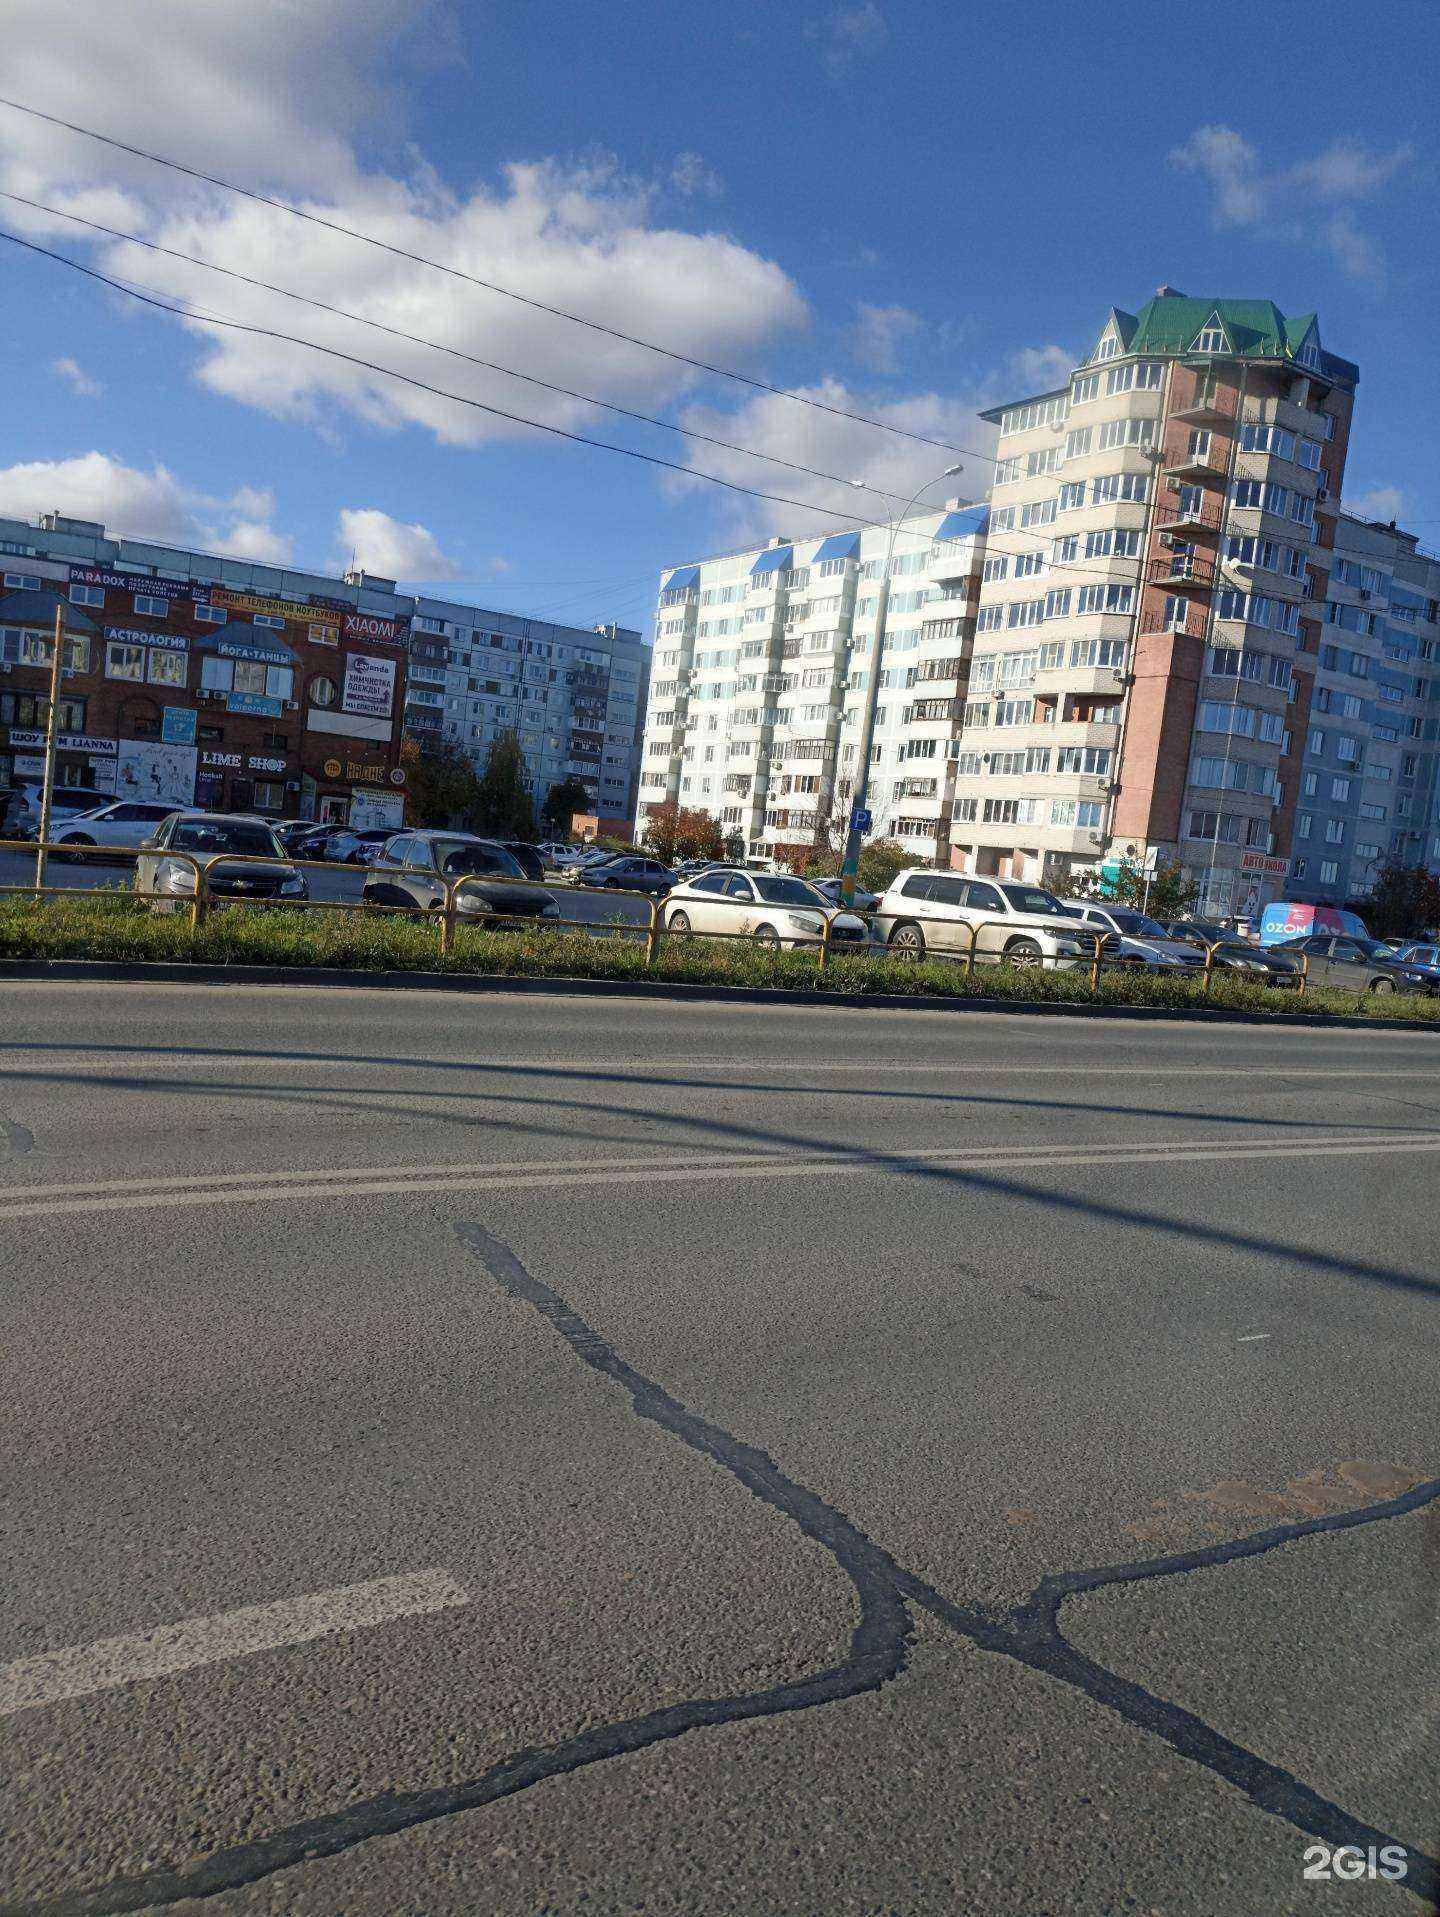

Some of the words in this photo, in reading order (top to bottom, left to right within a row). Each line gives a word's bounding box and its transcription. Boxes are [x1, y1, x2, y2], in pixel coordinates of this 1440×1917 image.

[71, 568, 126, 588] PARADOX
[212, 590, 244, 604] РЕМОНТ
[248, 594, 295, 613] ТЕЛЕФОНОВ
[296, 605, 340, 620] НОУТБУКОВ
[345, 615, 395, 637] XIAOMI
[109, 630, 187, 648] АСТРОЛОГИЯ
[347, 682, 380, 695] ОДЕЖДЫ
[348, 673, 391, 687] ХИМЧИСТКА
[12, 731, 39, 743] ШОУ
[202, 751, 242, 768] LIME
[248, 756, 287, 772] SHOP
[1266, 922, 1307, 935] OZON
